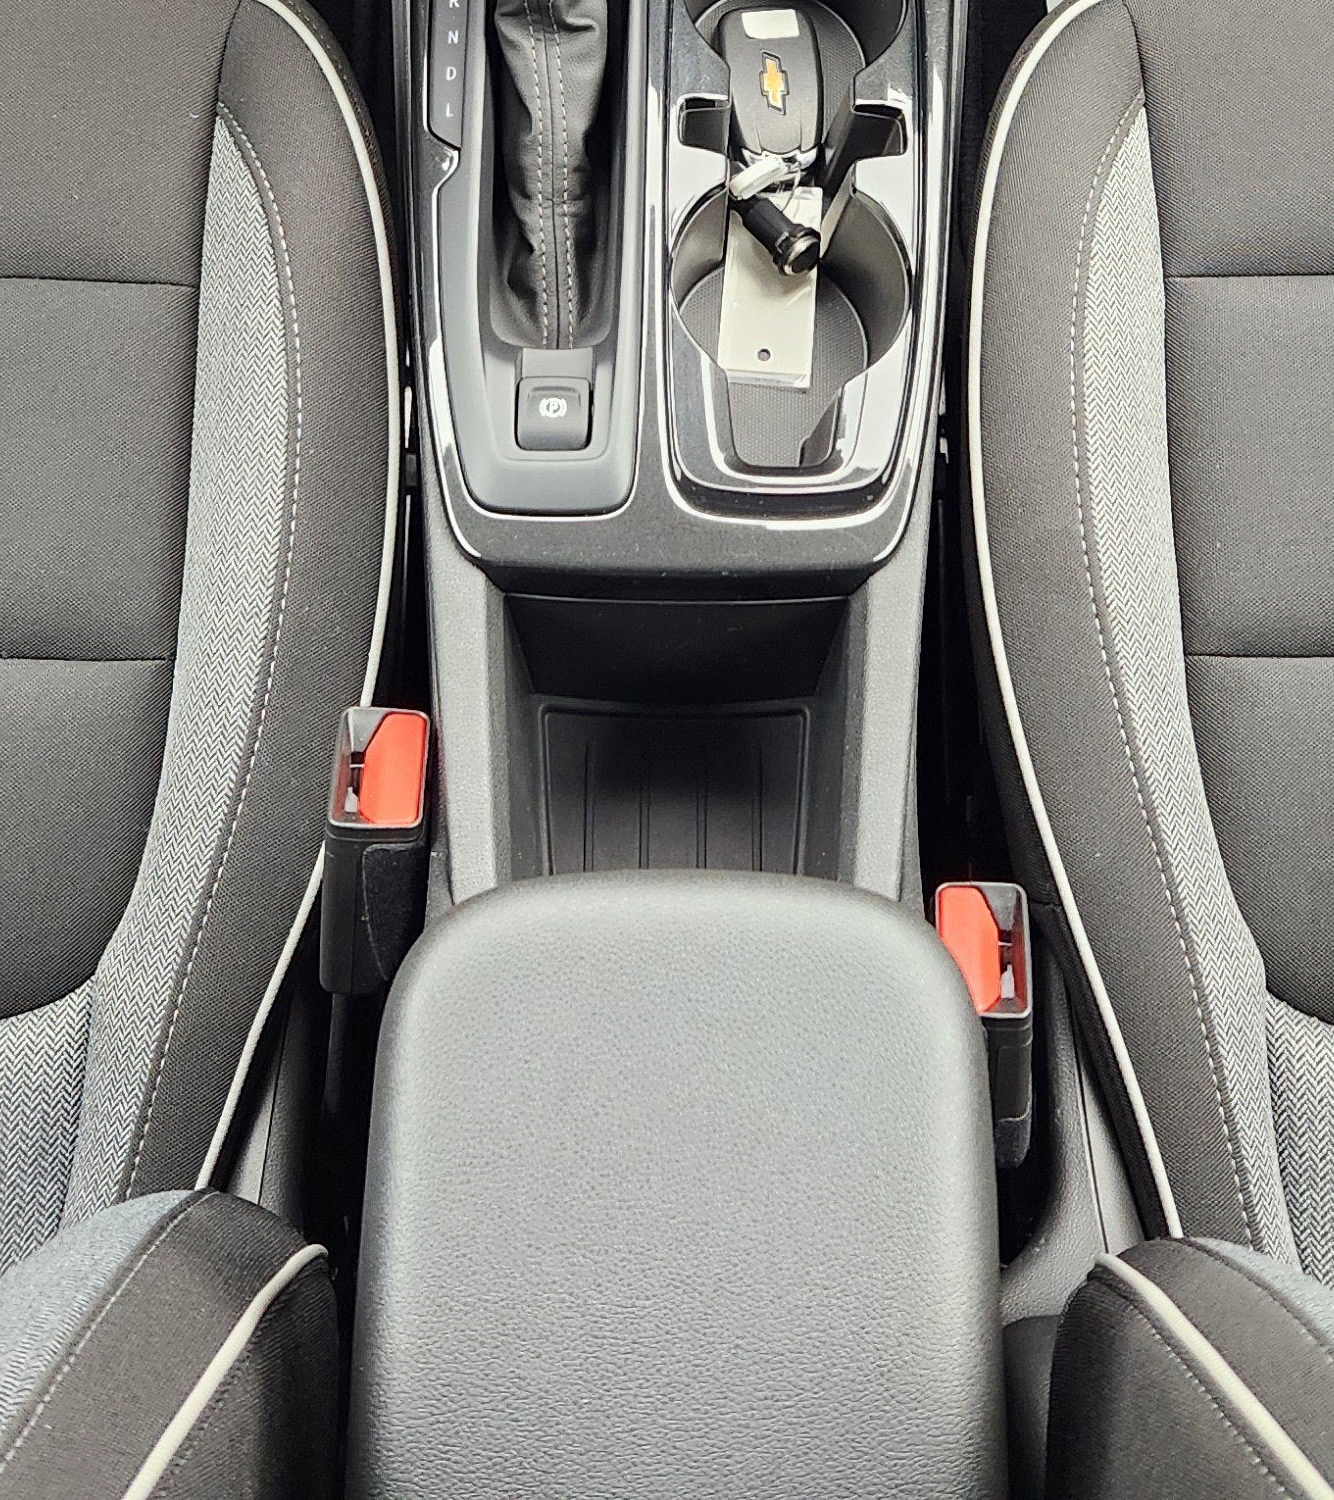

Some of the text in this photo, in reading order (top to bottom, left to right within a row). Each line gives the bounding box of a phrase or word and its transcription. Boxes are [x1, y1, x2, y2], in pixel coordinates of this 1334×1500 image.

[447, 30, 459, 45] N
[445, 65, 457, 81] D
[445, 103, 455, 119] L
